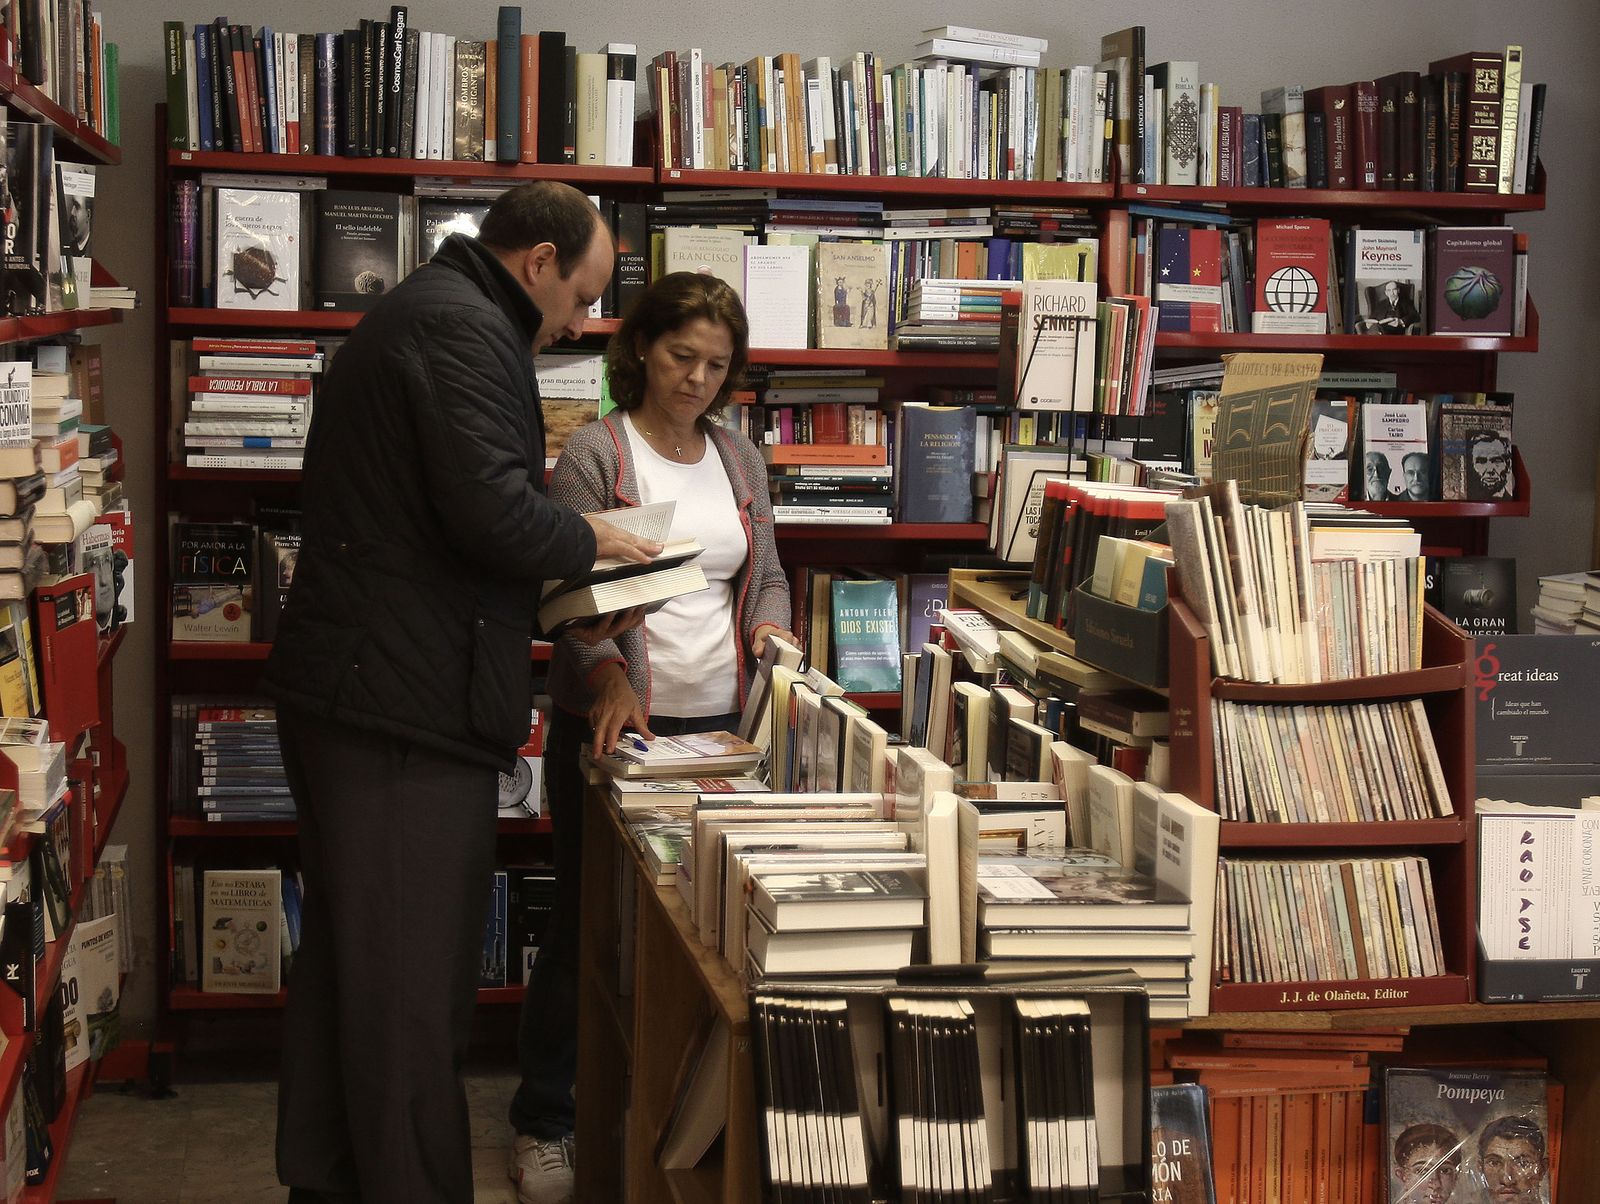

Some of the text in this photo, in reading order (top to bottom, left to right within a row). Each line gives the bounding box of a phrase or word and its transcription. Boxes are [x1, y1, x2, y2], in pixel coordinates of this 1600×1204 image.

[395, 11, 405, 40] Sagan
[461, 66, 469, 107] HOMBROS
[470, 64, 479, 106] GIGANTES
[1503, 70, 1520, 132] BIBLIA
[1450, 103, 1460, 129] Biblia
[1334, 116, 1343, 144] Jerusalén
[1427, 115, 1436, 139] Biblia
[1222, 132, 1230, 146] IGLESIA
[1334, 152, 1342, 169] Biblia
[1221, 159, 1229, 181] CATECISMO
[1446, 239, 1503, 247] Capitalismo global
[672, 251, 738, 263] FRANCISCO
[1361, 251, 1403, 263] Keynes
[1033, 294, 1087, 312] RICHARD
[208, 379, 279, 392] LA TABLA PERIÓDICA
[556, 377, 586, 386] migración
[1025, 506, 1040, 516] LAS
[82, 531, 111, 545] Habermas
[1135, 529, 1148, 537] Emil
[182, 541, 199, 550] POR
[200, 541, 226, 550] AMOR
[179, 550, 247, 575] FÍSICA
[839, 608, 869, 618] ANTONY
[184, 623, 240, 633] Walter Lewin
[840, 620, 896, 635] DIOS EXISTE
[1455, 617, 1506, 627] LA GRAN
[1526, 668, 1559, 682] ideas
[1582, 829, 1593, 863] CORONA
[234, 880, 266, 889] ESTABA
[230, 889, 257, 897] LIBRO
[210, 898, 272, 907] MATEMÁTICAS
[81, 938, 98, 950] PUNTOS
[1280, 988, 1409, 1003] J. J. de Olañeta, Editor
[1469, 1073, 1490, 1082] Berry
[1436, 1083, 1506, 1104] Pompeya
[1172, 1139, 1191, 1156] DE
